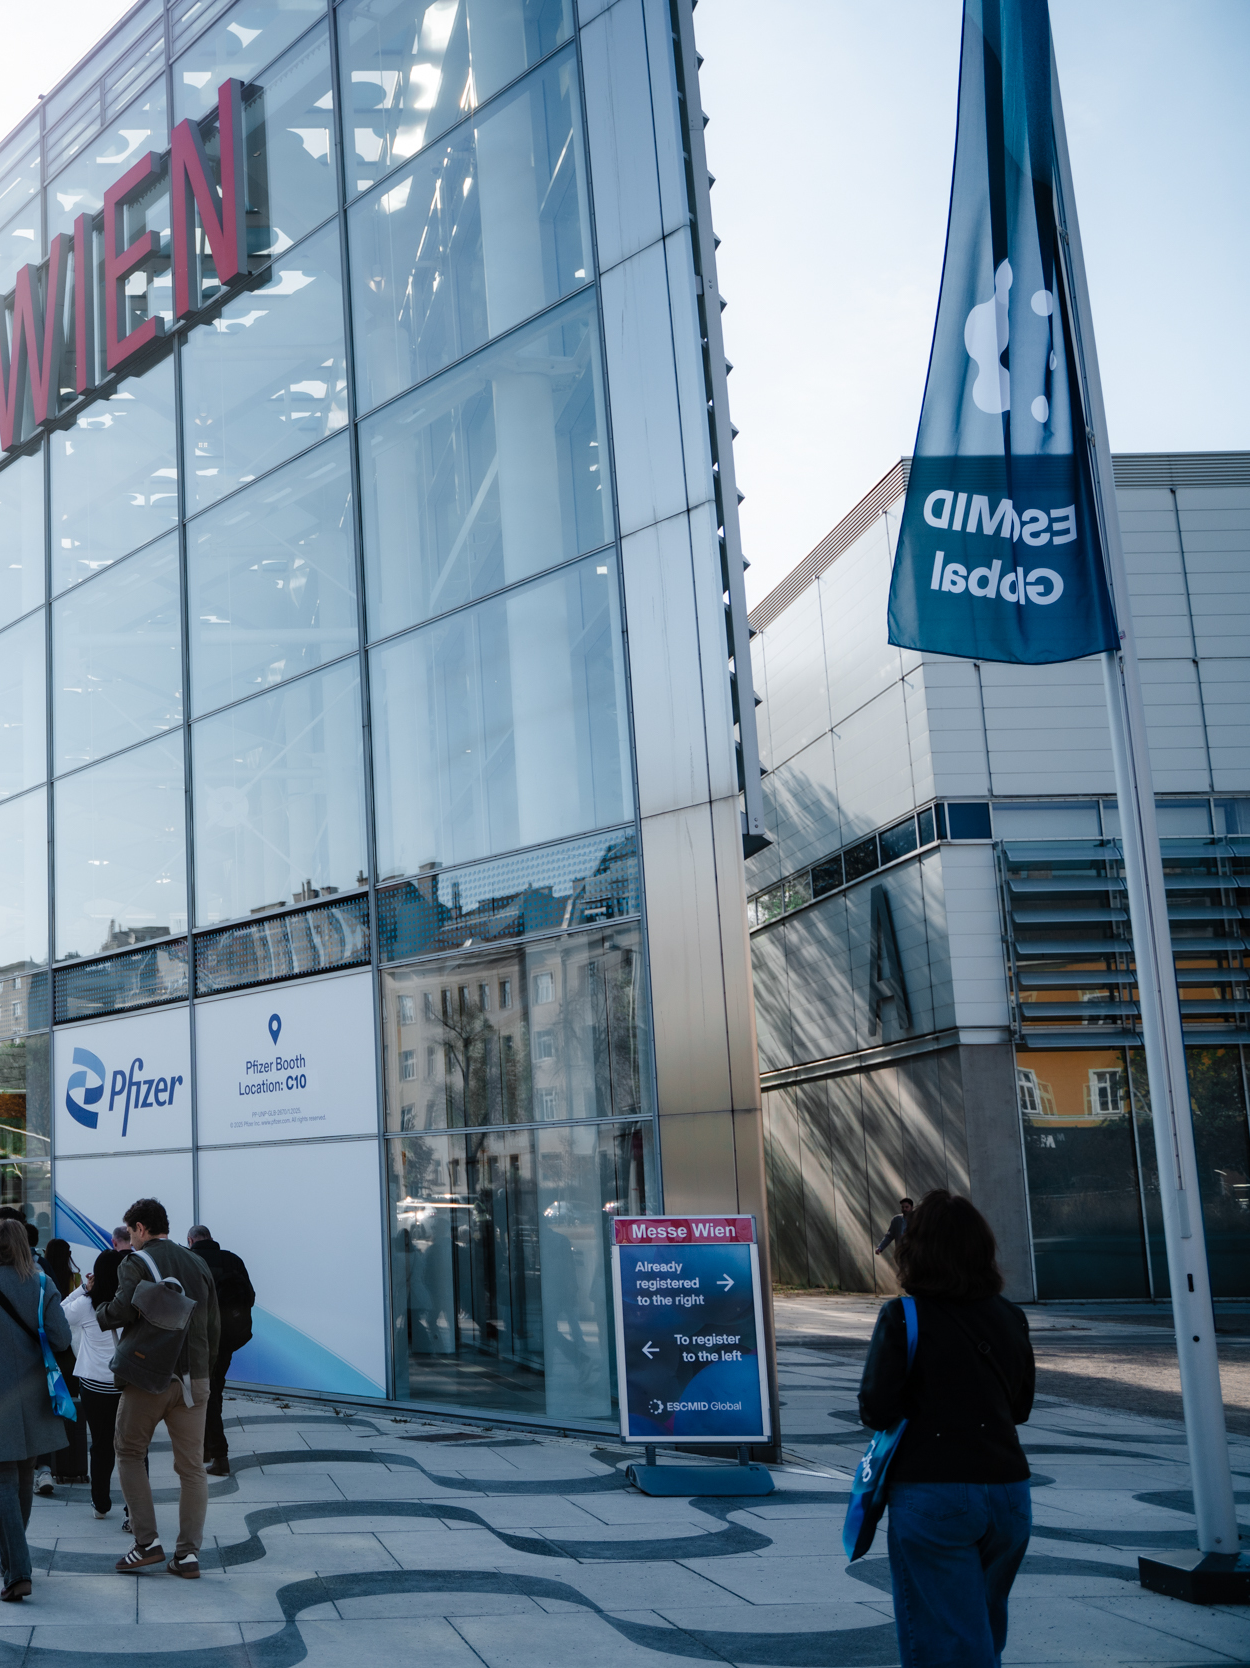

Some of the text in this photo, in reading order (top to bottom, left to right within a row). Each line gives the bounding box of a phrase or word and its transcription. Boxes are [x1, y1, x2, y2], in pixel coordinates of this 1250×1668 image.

[867, 883, 910, 1038] A
[246, 1053, 306, 1075] Pfizer Booth
[239, 1073, 307, 1096] Location: C10
[108, 1057, 183, 1137] Pfizer
[632, 1223, 736, 1239] Messe Wien
[635, 1261, 683, 1274] Already
[636, 1277, 700, 1291] registered
[637, 1294, 705, 1307] to the right
[674, 1333, 741, 1347] To register
[682, 1350, 742, 1361] to the left
[666, 1401, 742, 1411] ESCMID Global
